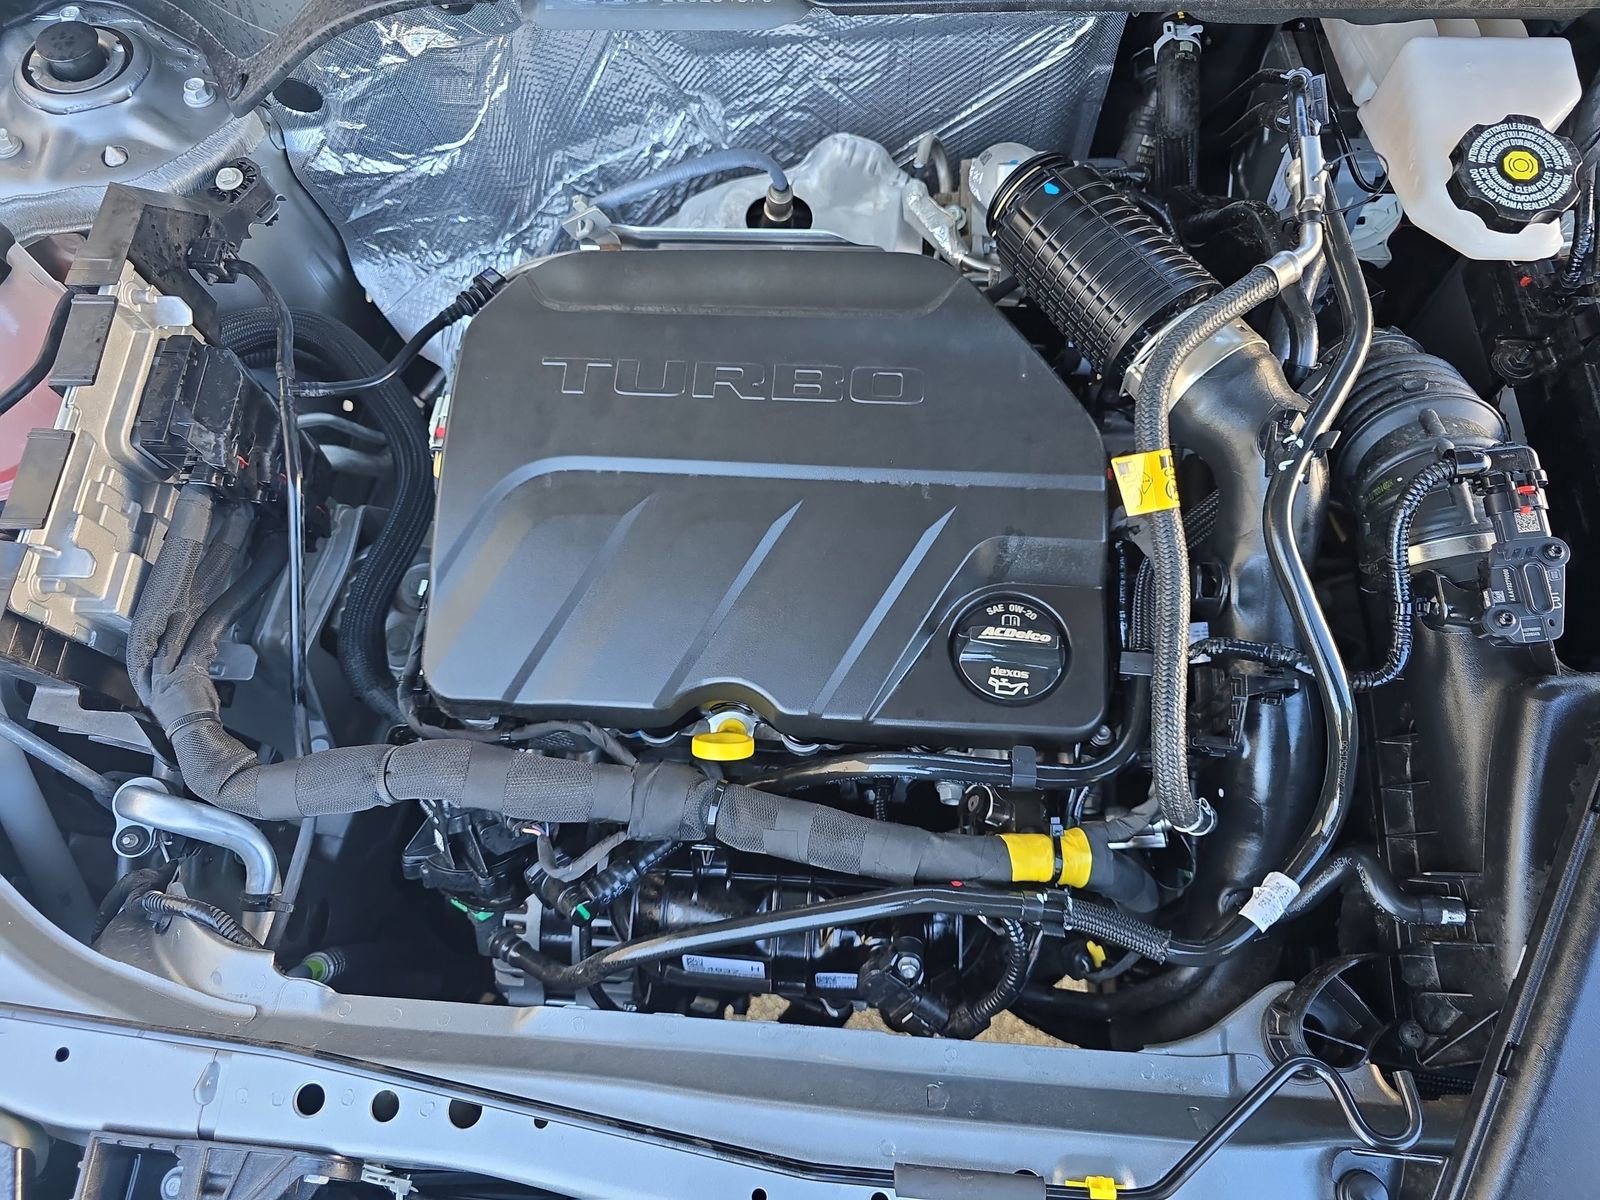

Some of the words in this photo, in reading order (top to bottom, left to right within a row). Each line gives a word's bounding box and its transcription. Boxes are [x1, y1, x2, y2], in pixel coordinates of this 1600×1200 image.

[1469, 168, 1482, 181] DOT
[1478, 183, 1497, 200] FLUID
[1495, 196, 1517, 208] FROM
[1522, 199, 1550, 210] SEALED
[1478, 167, 1491, 180] CAP
[1485, 178, 1510, 198] BEFORE
[1550, 172, 1563, 188] ONLY
[1515, 184, 1539, 194] CLEAN
[1535, 171, 1553, 189] FILLER
[541, 356, 925, 405] TURBO
[986, 604, 1005, 616] SAE
[1008, 604, 1038, 621] 0W-20
[980, 626, 1052, 642] ACDelco
[990, 666, 1030, 679] dexos
